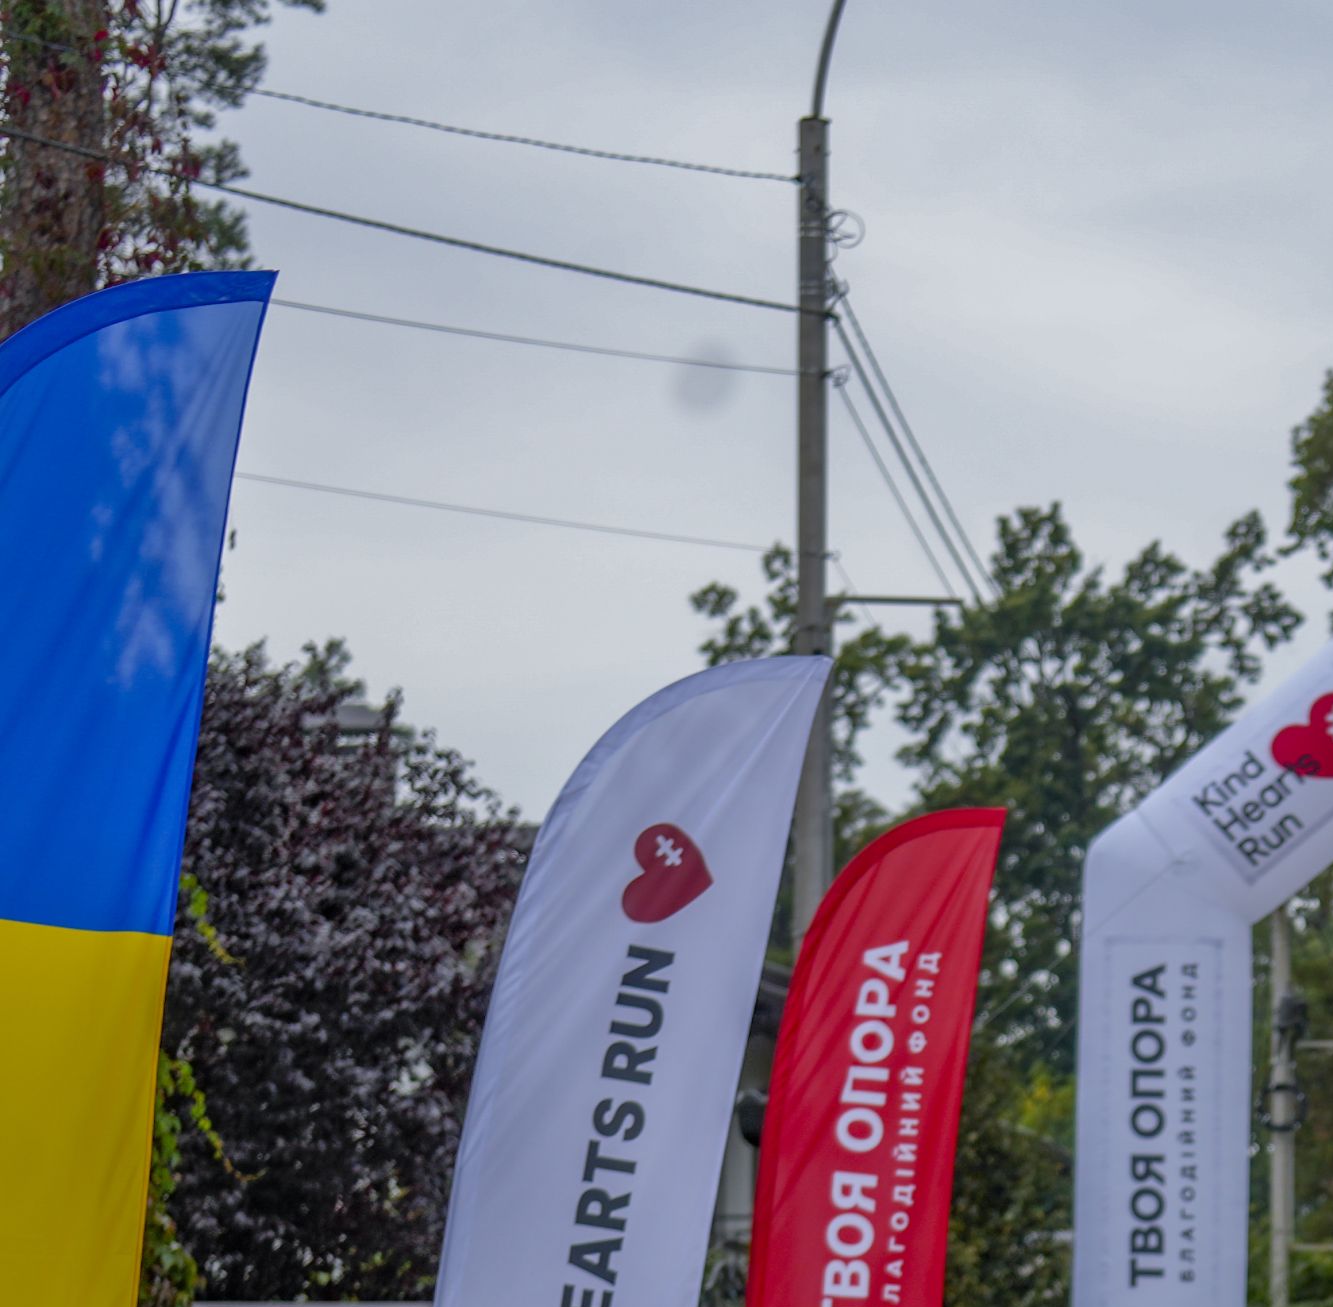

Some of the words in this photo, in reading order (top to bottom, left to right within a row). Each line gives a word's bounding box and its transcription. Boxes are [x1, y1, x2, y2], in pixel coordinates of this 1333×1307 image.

[1192, 749, 1266, 817] Kind
[1212, 753, 1322, 842] Hearts
[1236, 813, 1304, 866] Run
[601, 944, 676, 1085] RUN
[835, 940, 910, 1153] ОПОРА
[908, 951, 942, 1054] ФОНД
[1130, 963, 1167, 1139] ОПОРА
[1180, 963, 1199, 1047] ФОНД
[1129, 1154, 1166, 1288] ТВОЯ
